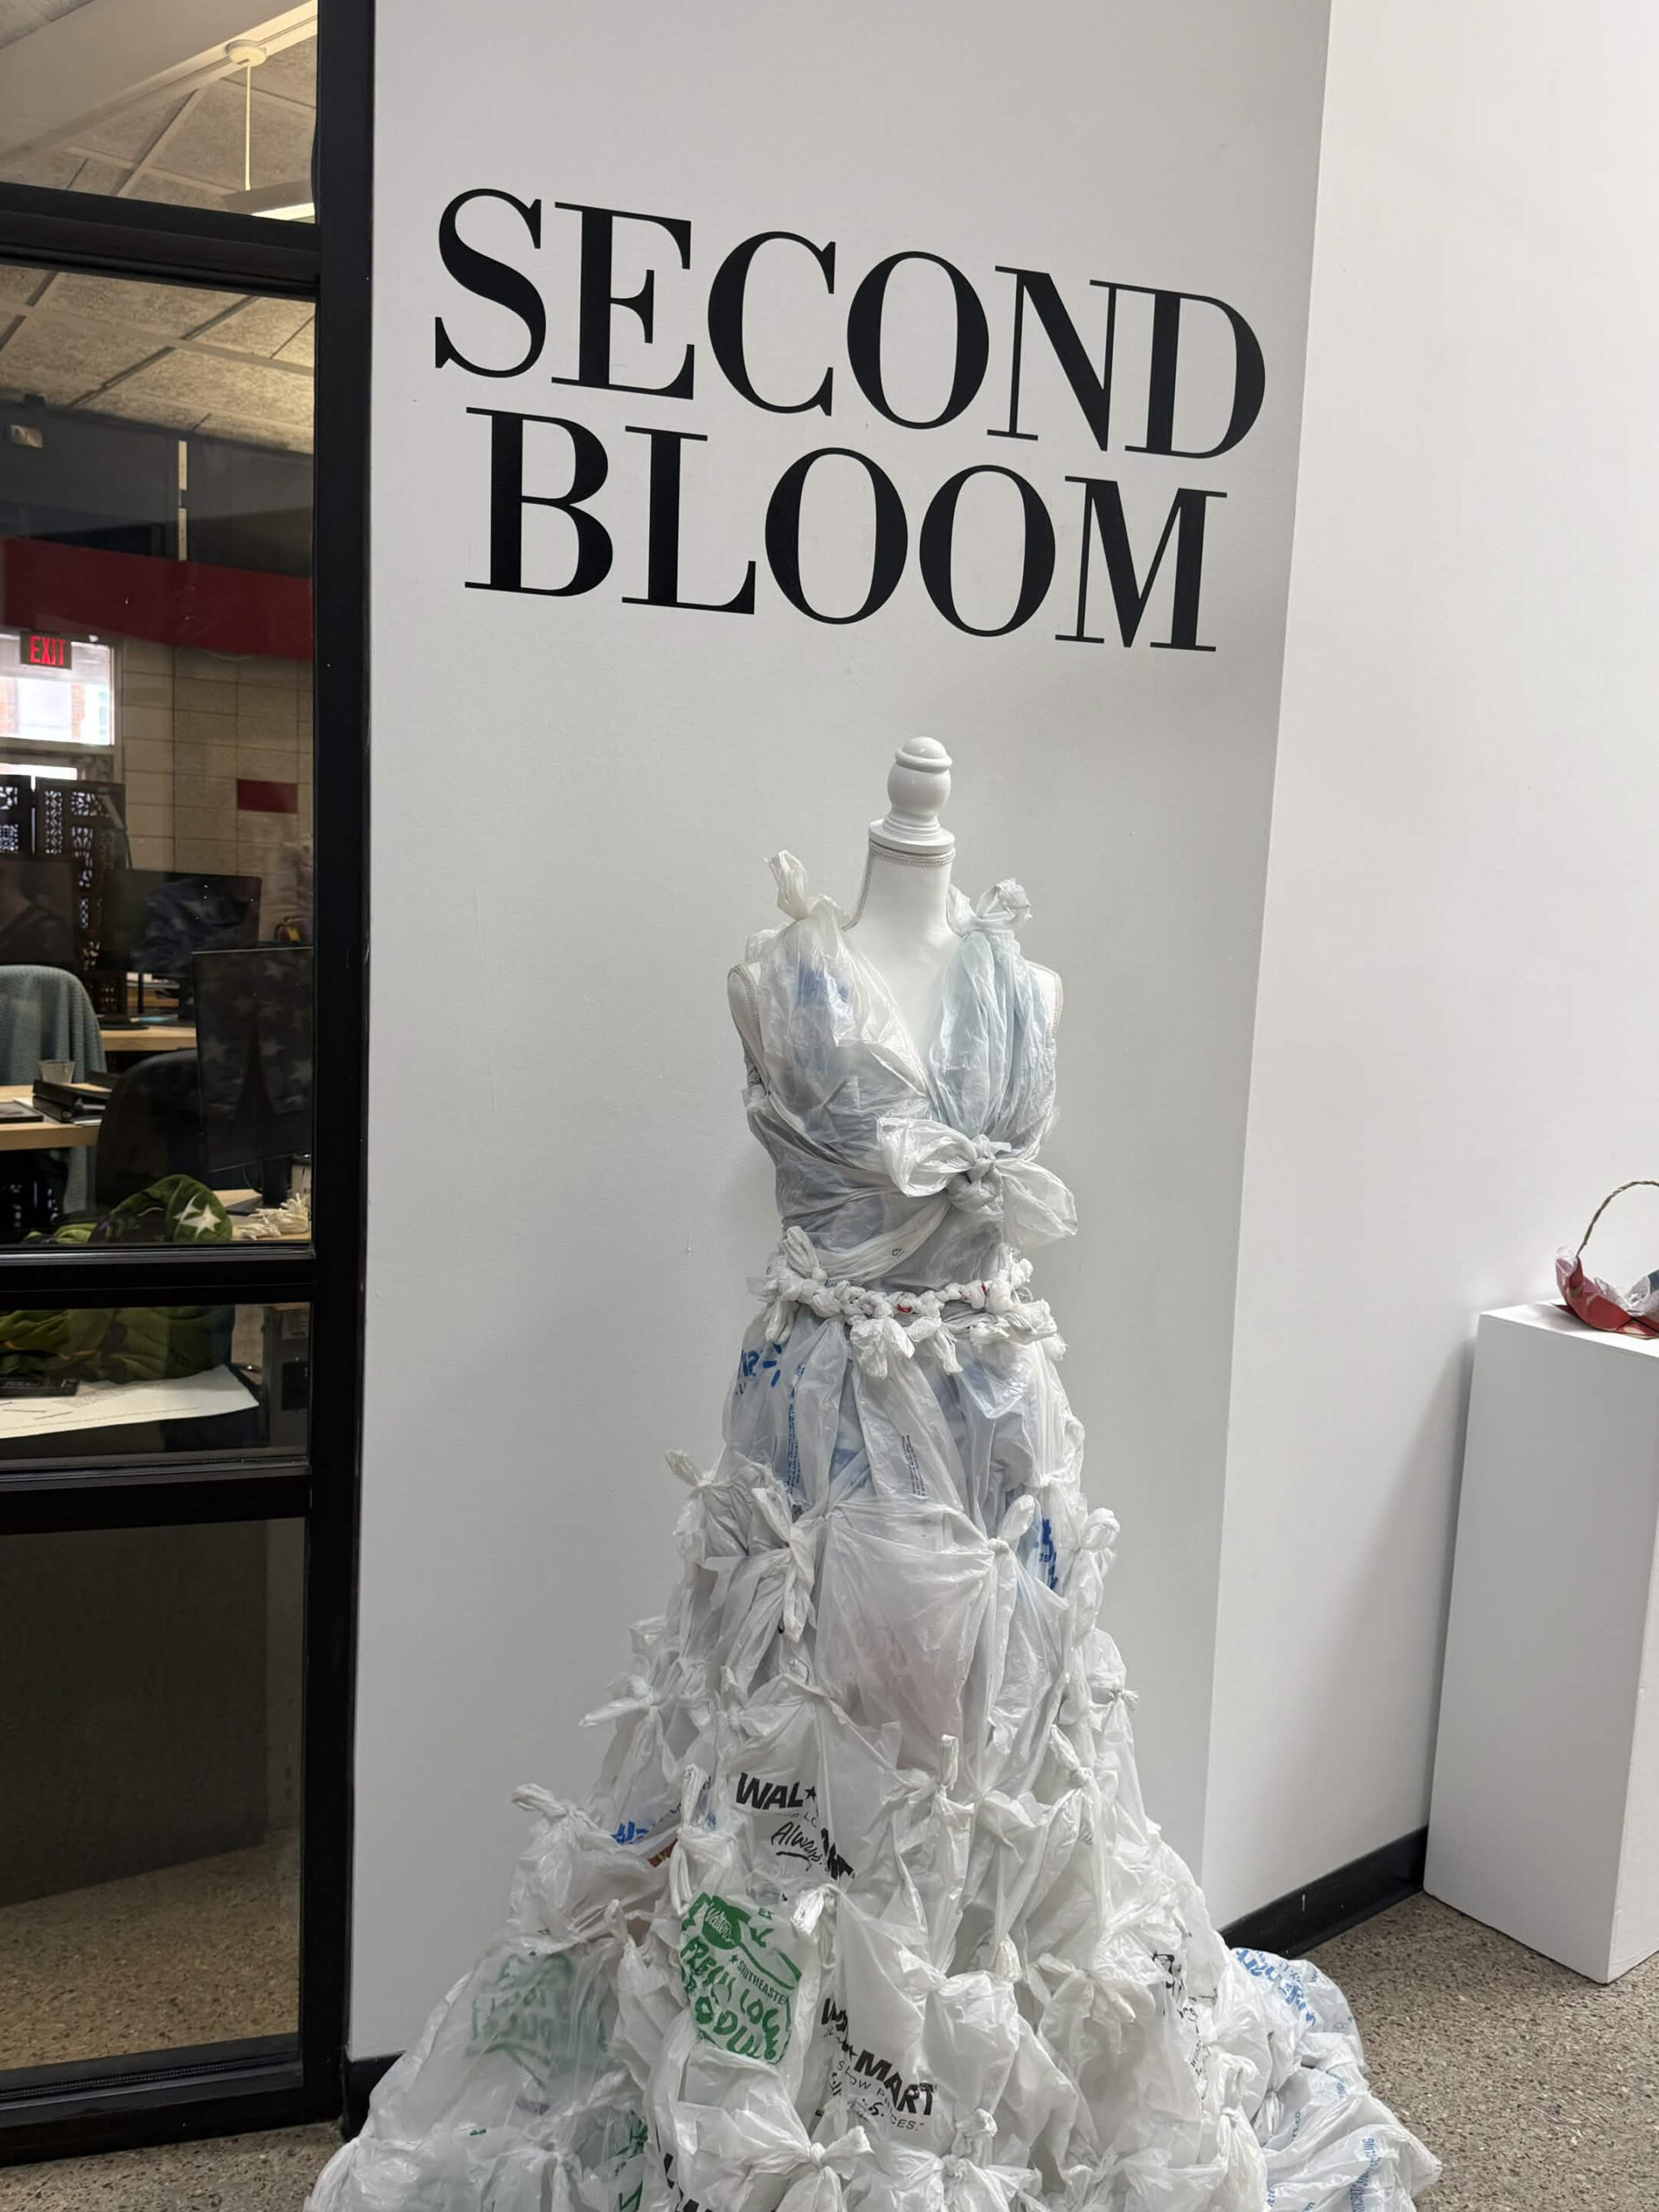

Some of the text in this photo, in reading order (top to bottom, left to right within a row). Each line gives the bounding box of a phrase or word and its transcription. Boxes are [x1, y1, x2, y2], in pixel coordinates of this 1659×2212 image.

[435, 188, 1266, 459] SECOND
[29, 635, 67, 667] EXIT
[465, 406, 1228, 652] BLOOM
